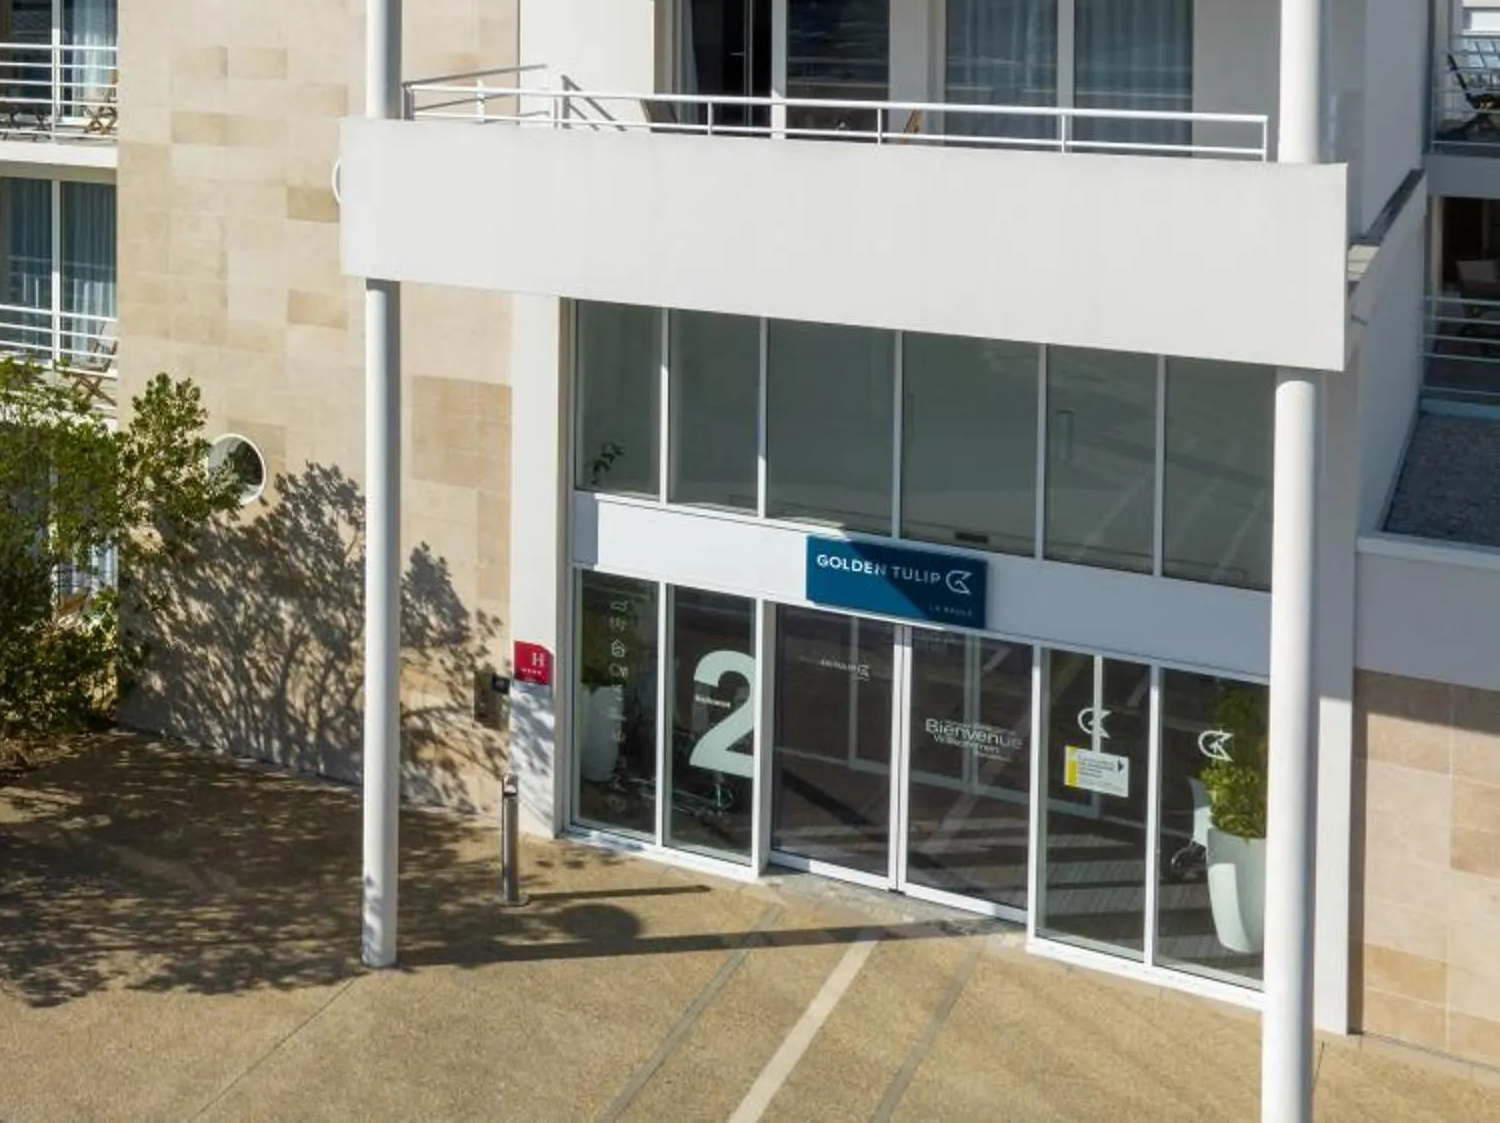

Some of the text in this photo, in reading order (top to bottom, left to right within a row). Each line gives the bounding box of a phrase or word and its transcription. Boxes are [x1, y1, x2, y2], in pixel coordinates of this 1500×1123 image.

[816, 553, 941, 584] GOLDEN TULIP
[689, 650, 756, 778] 2
[925, 718, 1024, 750] Bienvenue
